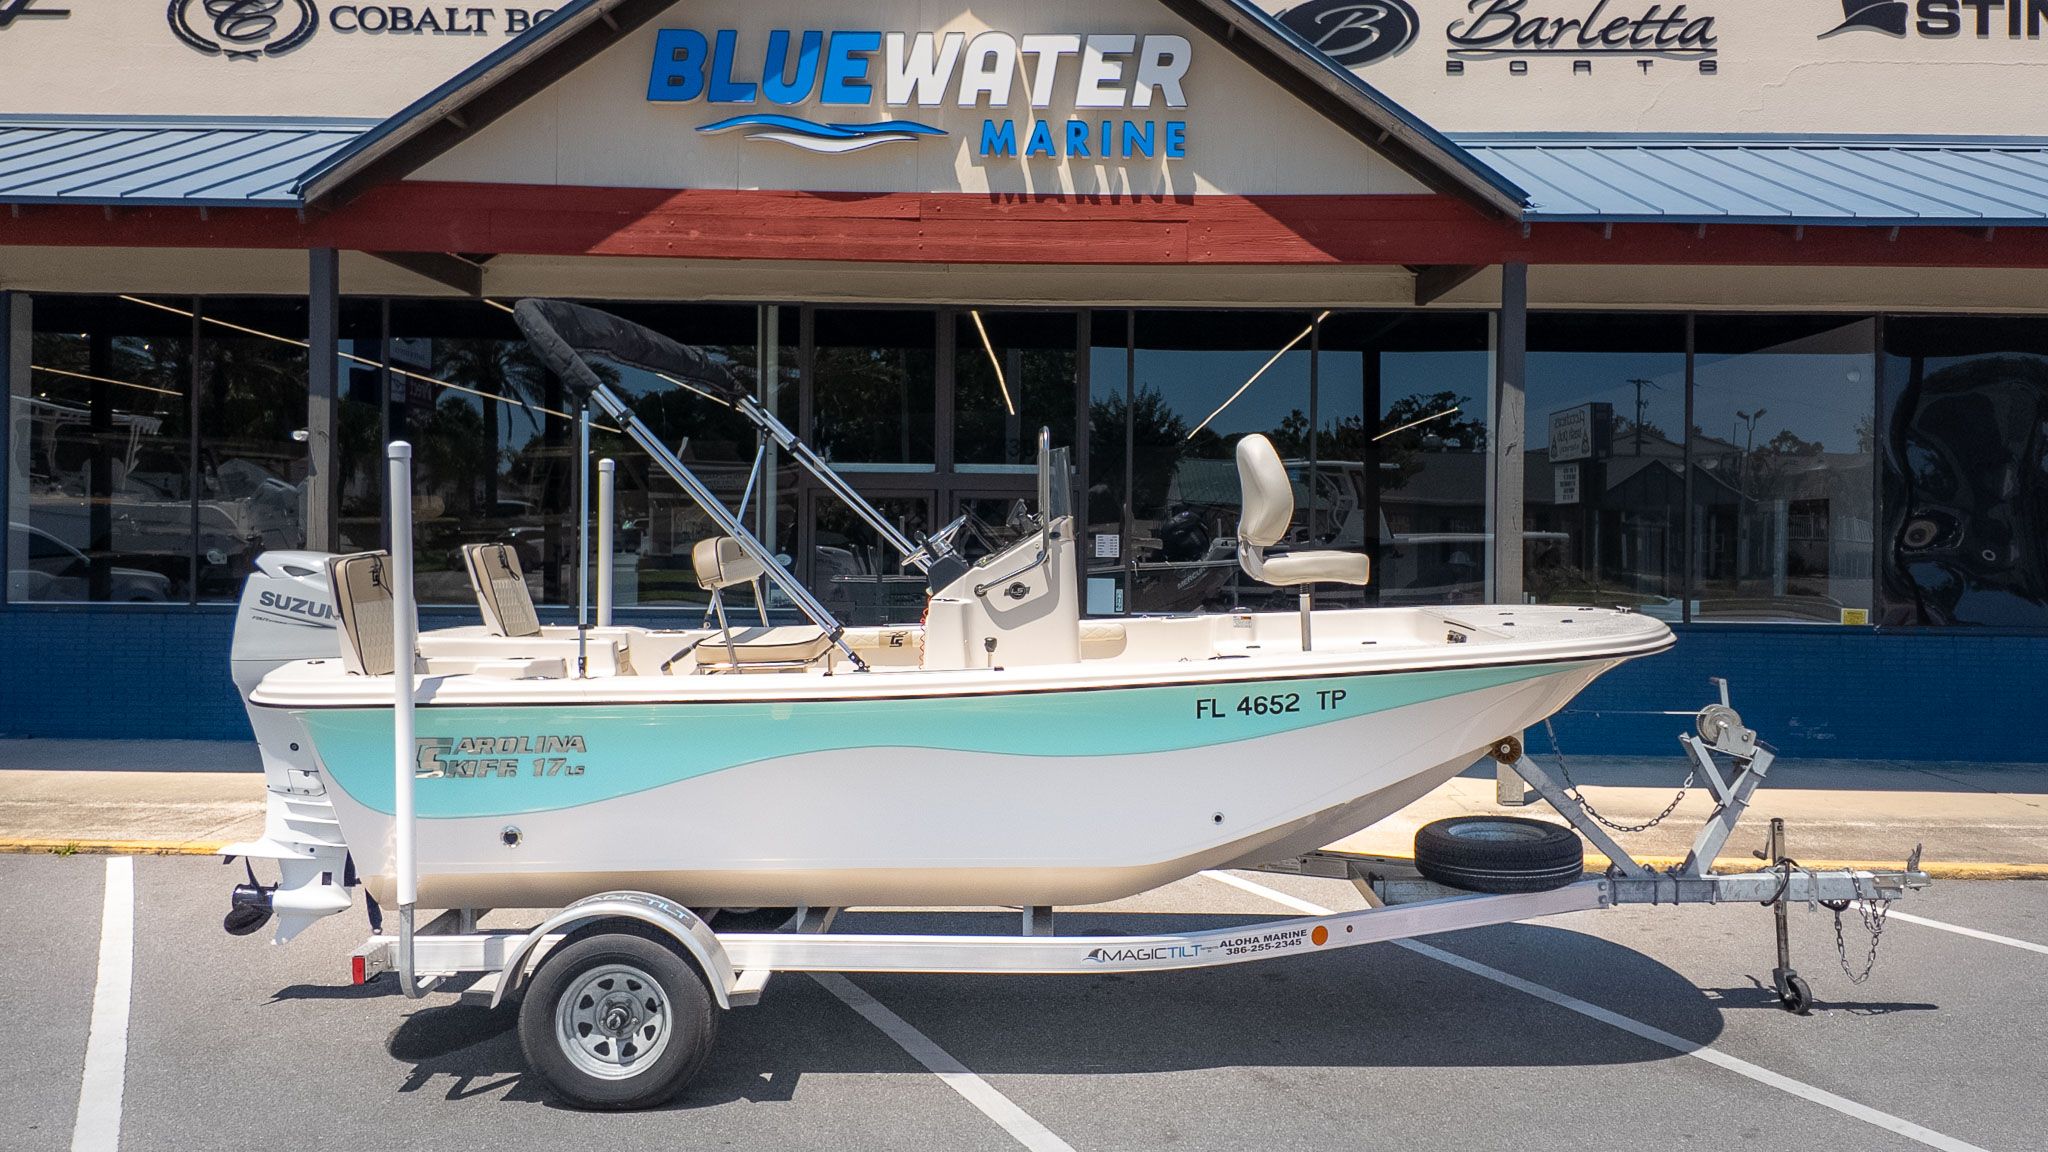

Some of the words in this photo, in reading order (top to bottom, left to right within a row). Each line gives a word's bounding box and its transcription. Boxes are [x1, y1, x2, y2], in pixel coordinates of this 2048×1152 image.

[329, 5, 496, 35] COBALT
[1446, 0, 1718, 48] Barletta
[647, 28, 1192, 109] BLUEWATER
[1446, 60, 1718, 76] BOATS
[979, 119, 1188, 159] MARINE
[1196, 698, 1226, 719] FL
[1236, 693, 1300, 716] 4652
[1316, 689, 1347, 710] TP
[1101, 945, 1203, 962] MAGICTILT
[1220, 936, 1260, 948] ALOHA
[1263, 929, 1307, 943] MARINE
[1226, 938, 1302, 955] 386-255-2345
